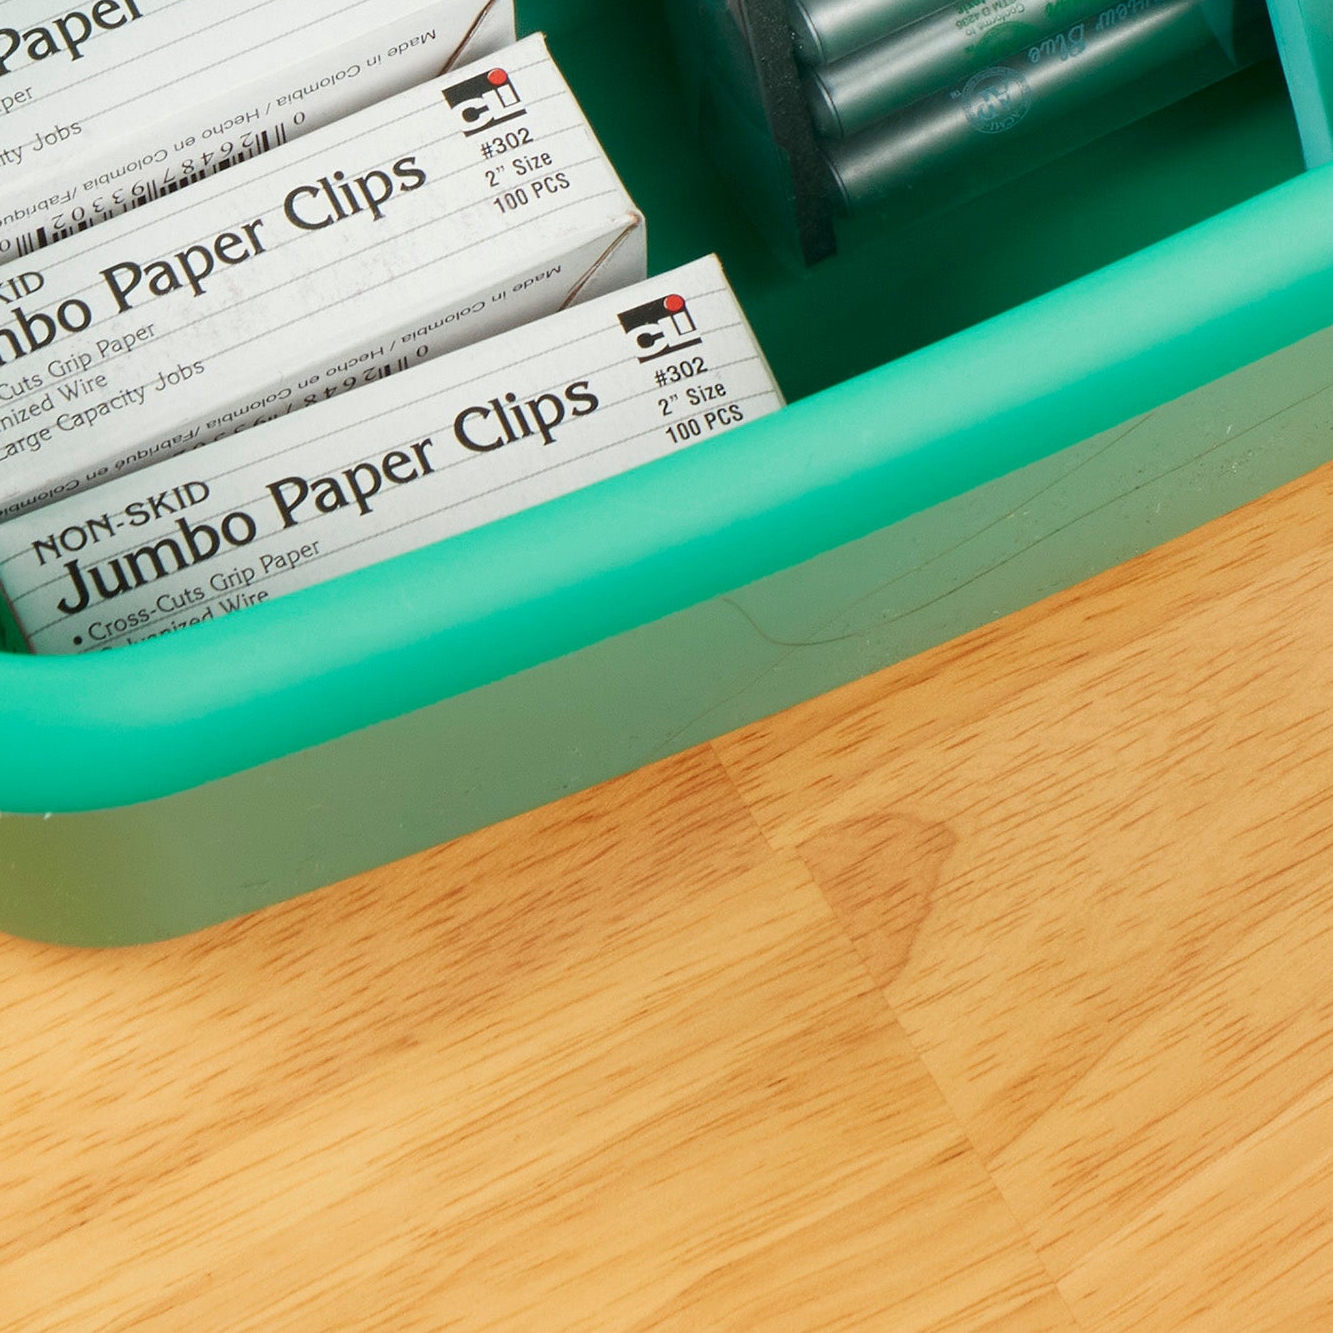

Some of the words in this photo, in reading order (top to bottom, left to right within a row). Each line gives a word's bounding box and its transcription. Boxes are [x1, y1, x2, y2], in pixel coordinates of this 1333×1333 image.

[387, 29, 437, 57] Made
[1028, 23, 1086, 65] Blue
[366, 53, 382, 67] in
[276, 64, 361, 107] Colombia
[32, 121, 83, 152] Jobs
[201, 108, 261, 139] Hecho
[174, 135, 196, 152] en
[480, 127, 534, 160] #302
[83, 149, 168, 191] Colombia
[512, 150, 553, 177] Size
[493, 188, 529, 214] 100
[532, 172, 571, 198] PCS
[99, 218, 266, 314] Paper
[283, 156, 427, 230] Clips
[512, 265, 562, 293] Made
[491, 290, 507, 302] in
[401, 300, 486, 344] Colombia
[48, 351, 93, 378] Grip
[96, 322, 157, 358] Paper
[326, 345, 385, 377] Hecho
[298, 373, 320, 389] en
[655, 356, 709, 387] #302
[56, 383, 146, 432] Capacity
[155, 360, 206, 392] Jobs
[57, 374, 109, 402] Wire
[685, 381, 727, 406] Size
[206, 388, 292, 429] Colombia
[665, 418, 702, 444] 100
[705, 403, 744, 431] PCS
[86, 465, 109, 479] en
[57, 511, 256, 615] Jumbo
[266, 437, 435, 530] Paper
[453, 381, 600, 452] Clips
[32, 481, 210, 566] NON-SKID
[88, 583, 206, 641] Cross-Cuts
[209, 564, 255, 593] Grip
[260, 540, 321, 577] Paper
